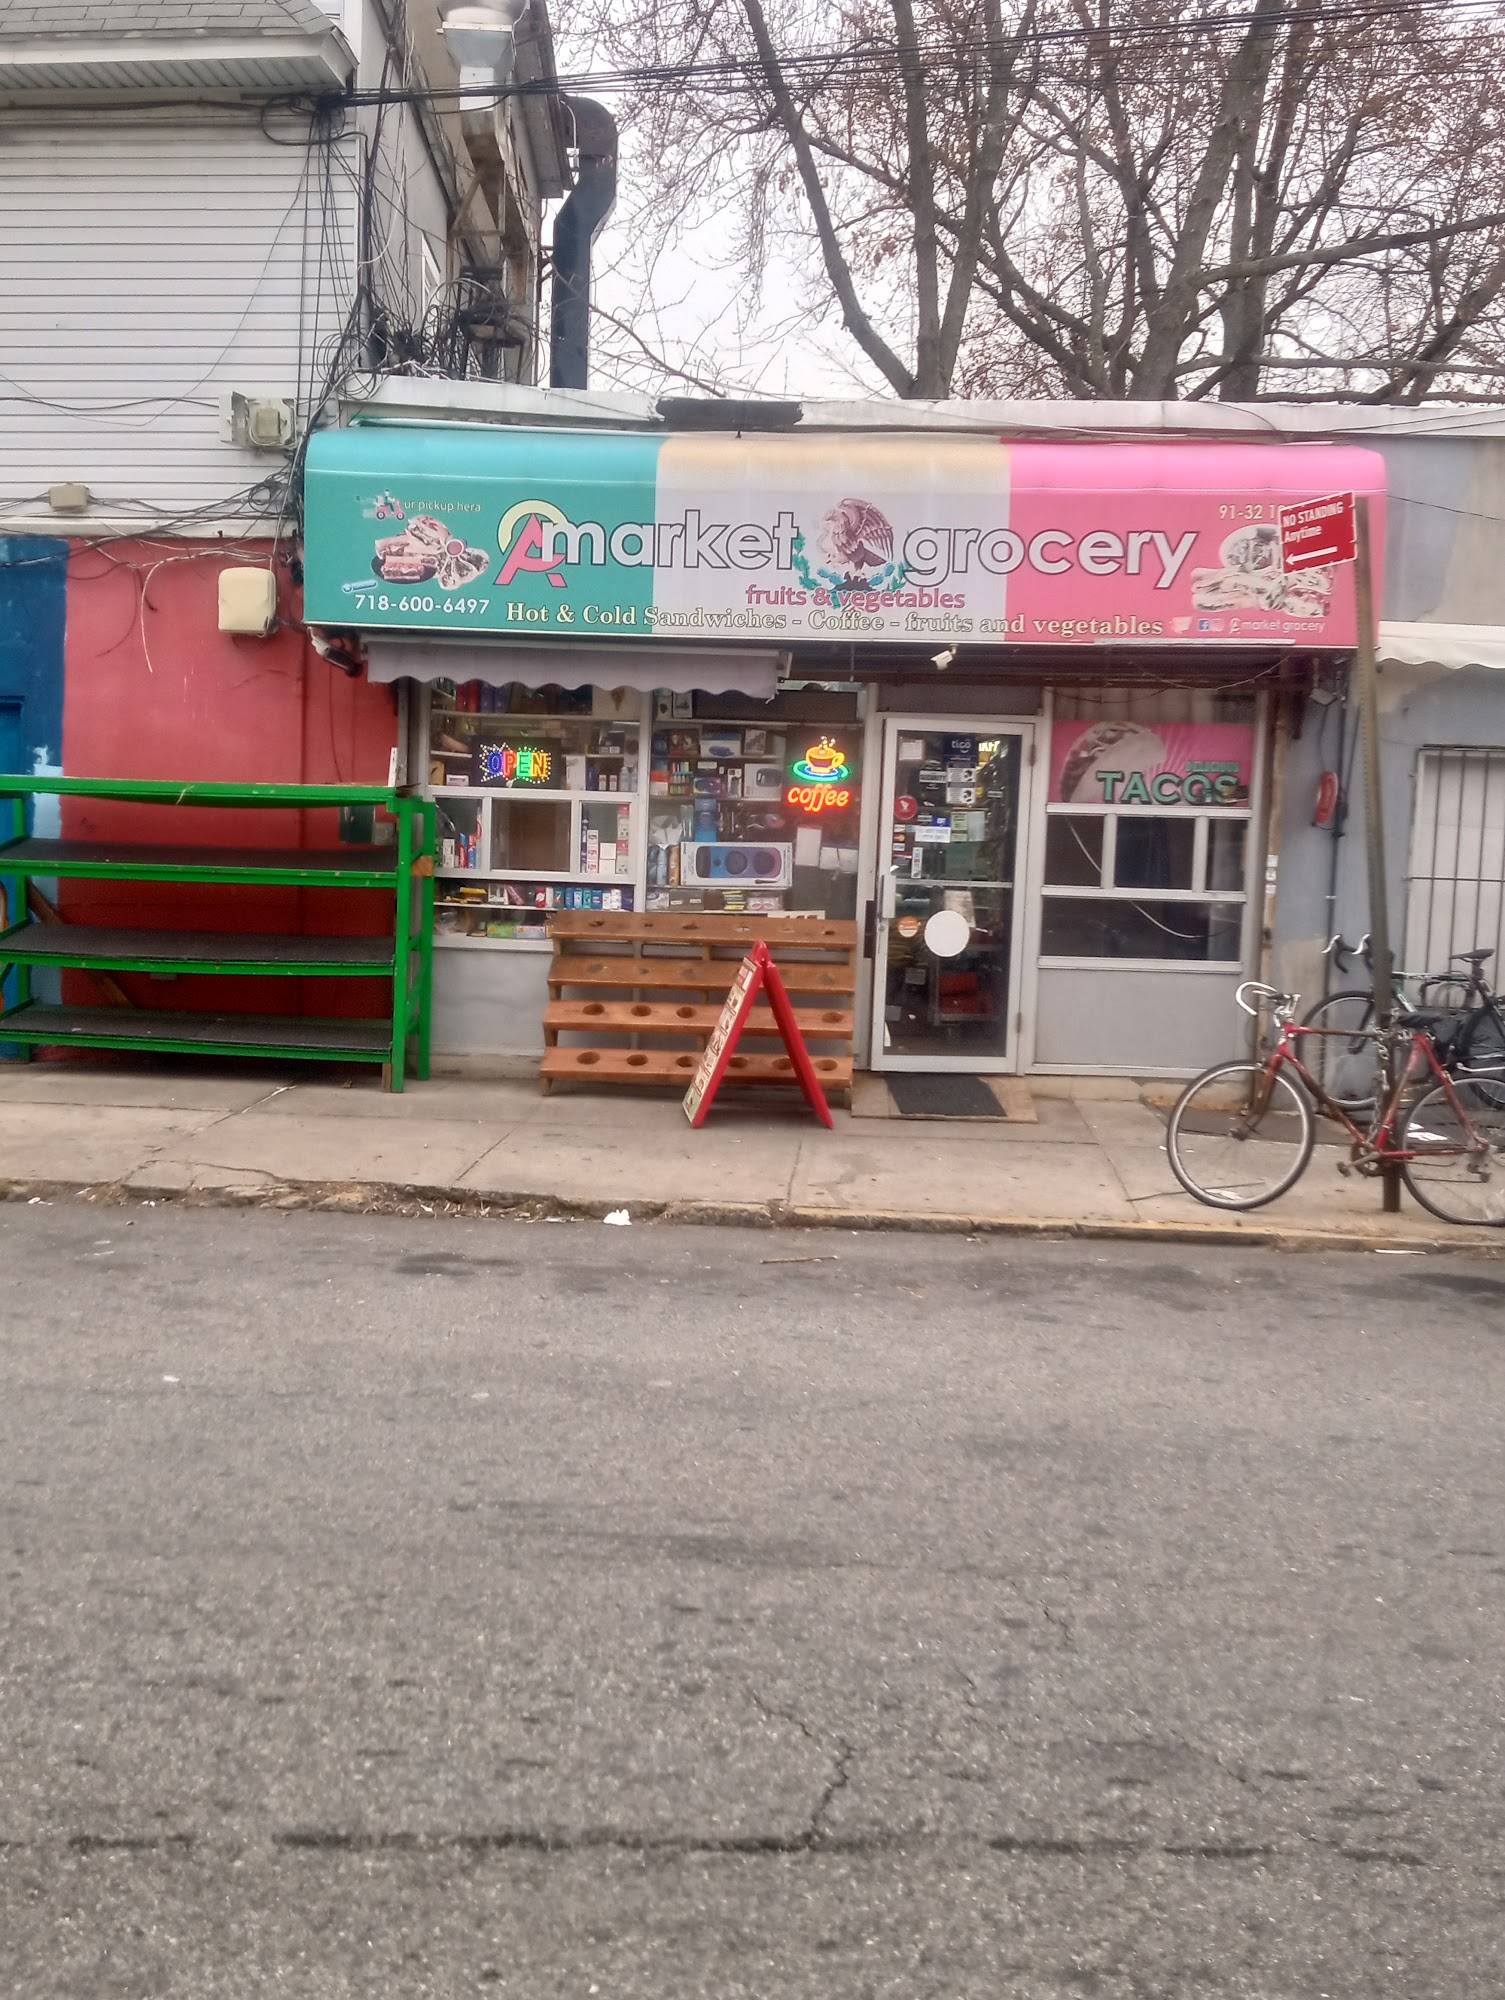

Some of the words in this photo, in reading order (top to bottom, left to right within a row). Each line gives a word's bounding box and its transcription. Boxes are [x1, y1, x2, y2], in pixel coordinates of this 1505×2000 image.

[418, 501, 454, 512] pickup
[1219, 504, 1263, 520] 91-32
[1282, 514, 1296, 528] NO
[1298, 502, 1344, 524] STANDING
[1284, 525, 1322, 543] Anytime
[903, 526, 1201, 590] grocery
[355, 594, 490, 615] 718-600-6497
[746, 585, 807, 606] fruits
[813, 588, 832, 607] &
[837, 587, 966, 613] vegetables
[506, 602, 550, 623] Hot
[556, 604, 575, 623] &
[583, 604, 637, 625] Cold
[643, 606, 787, 629] Sandwiches
[808, 609, 884, 631] Coffee
[905, 612, 973, 633] fruits
[979, 614, 1025, 634] and
[1033, 616, 1164, 638] vegetables
[1242, 620, 1280, 631] market
[1283, 621, 1325, 633] grocery
[487, 750, 548, 778] OPEN
[787, 784, 849, 813] coffee
[1096, 770, 1240, 805] TACOS
